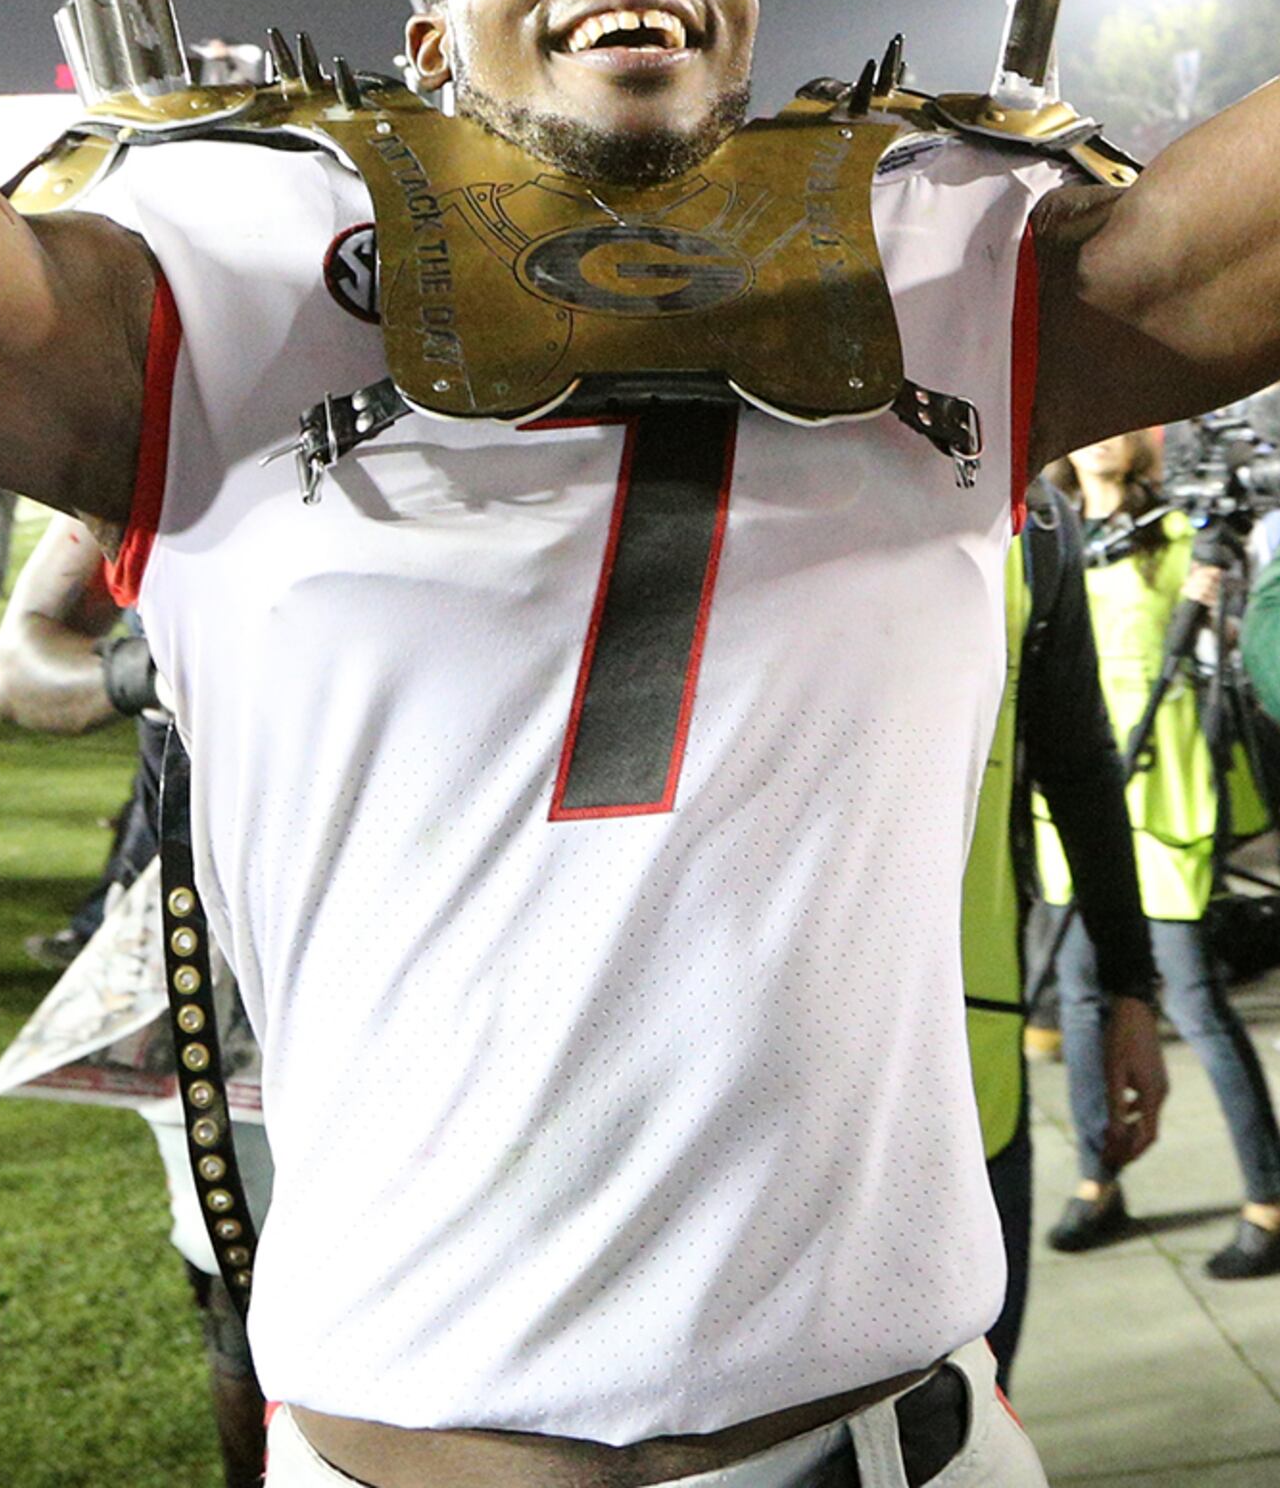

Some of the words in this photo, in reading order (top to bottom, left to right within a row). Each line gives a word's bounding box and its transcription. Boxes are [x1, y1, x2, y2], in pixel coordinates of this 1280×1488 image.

[368, 134, 443, 232] ATTACK
[418, 239, 453, 295] THE
[523, 224, 747, 312] G
[420, 306, 463, 363] DAY
[516, 397, 740, 822] 7
